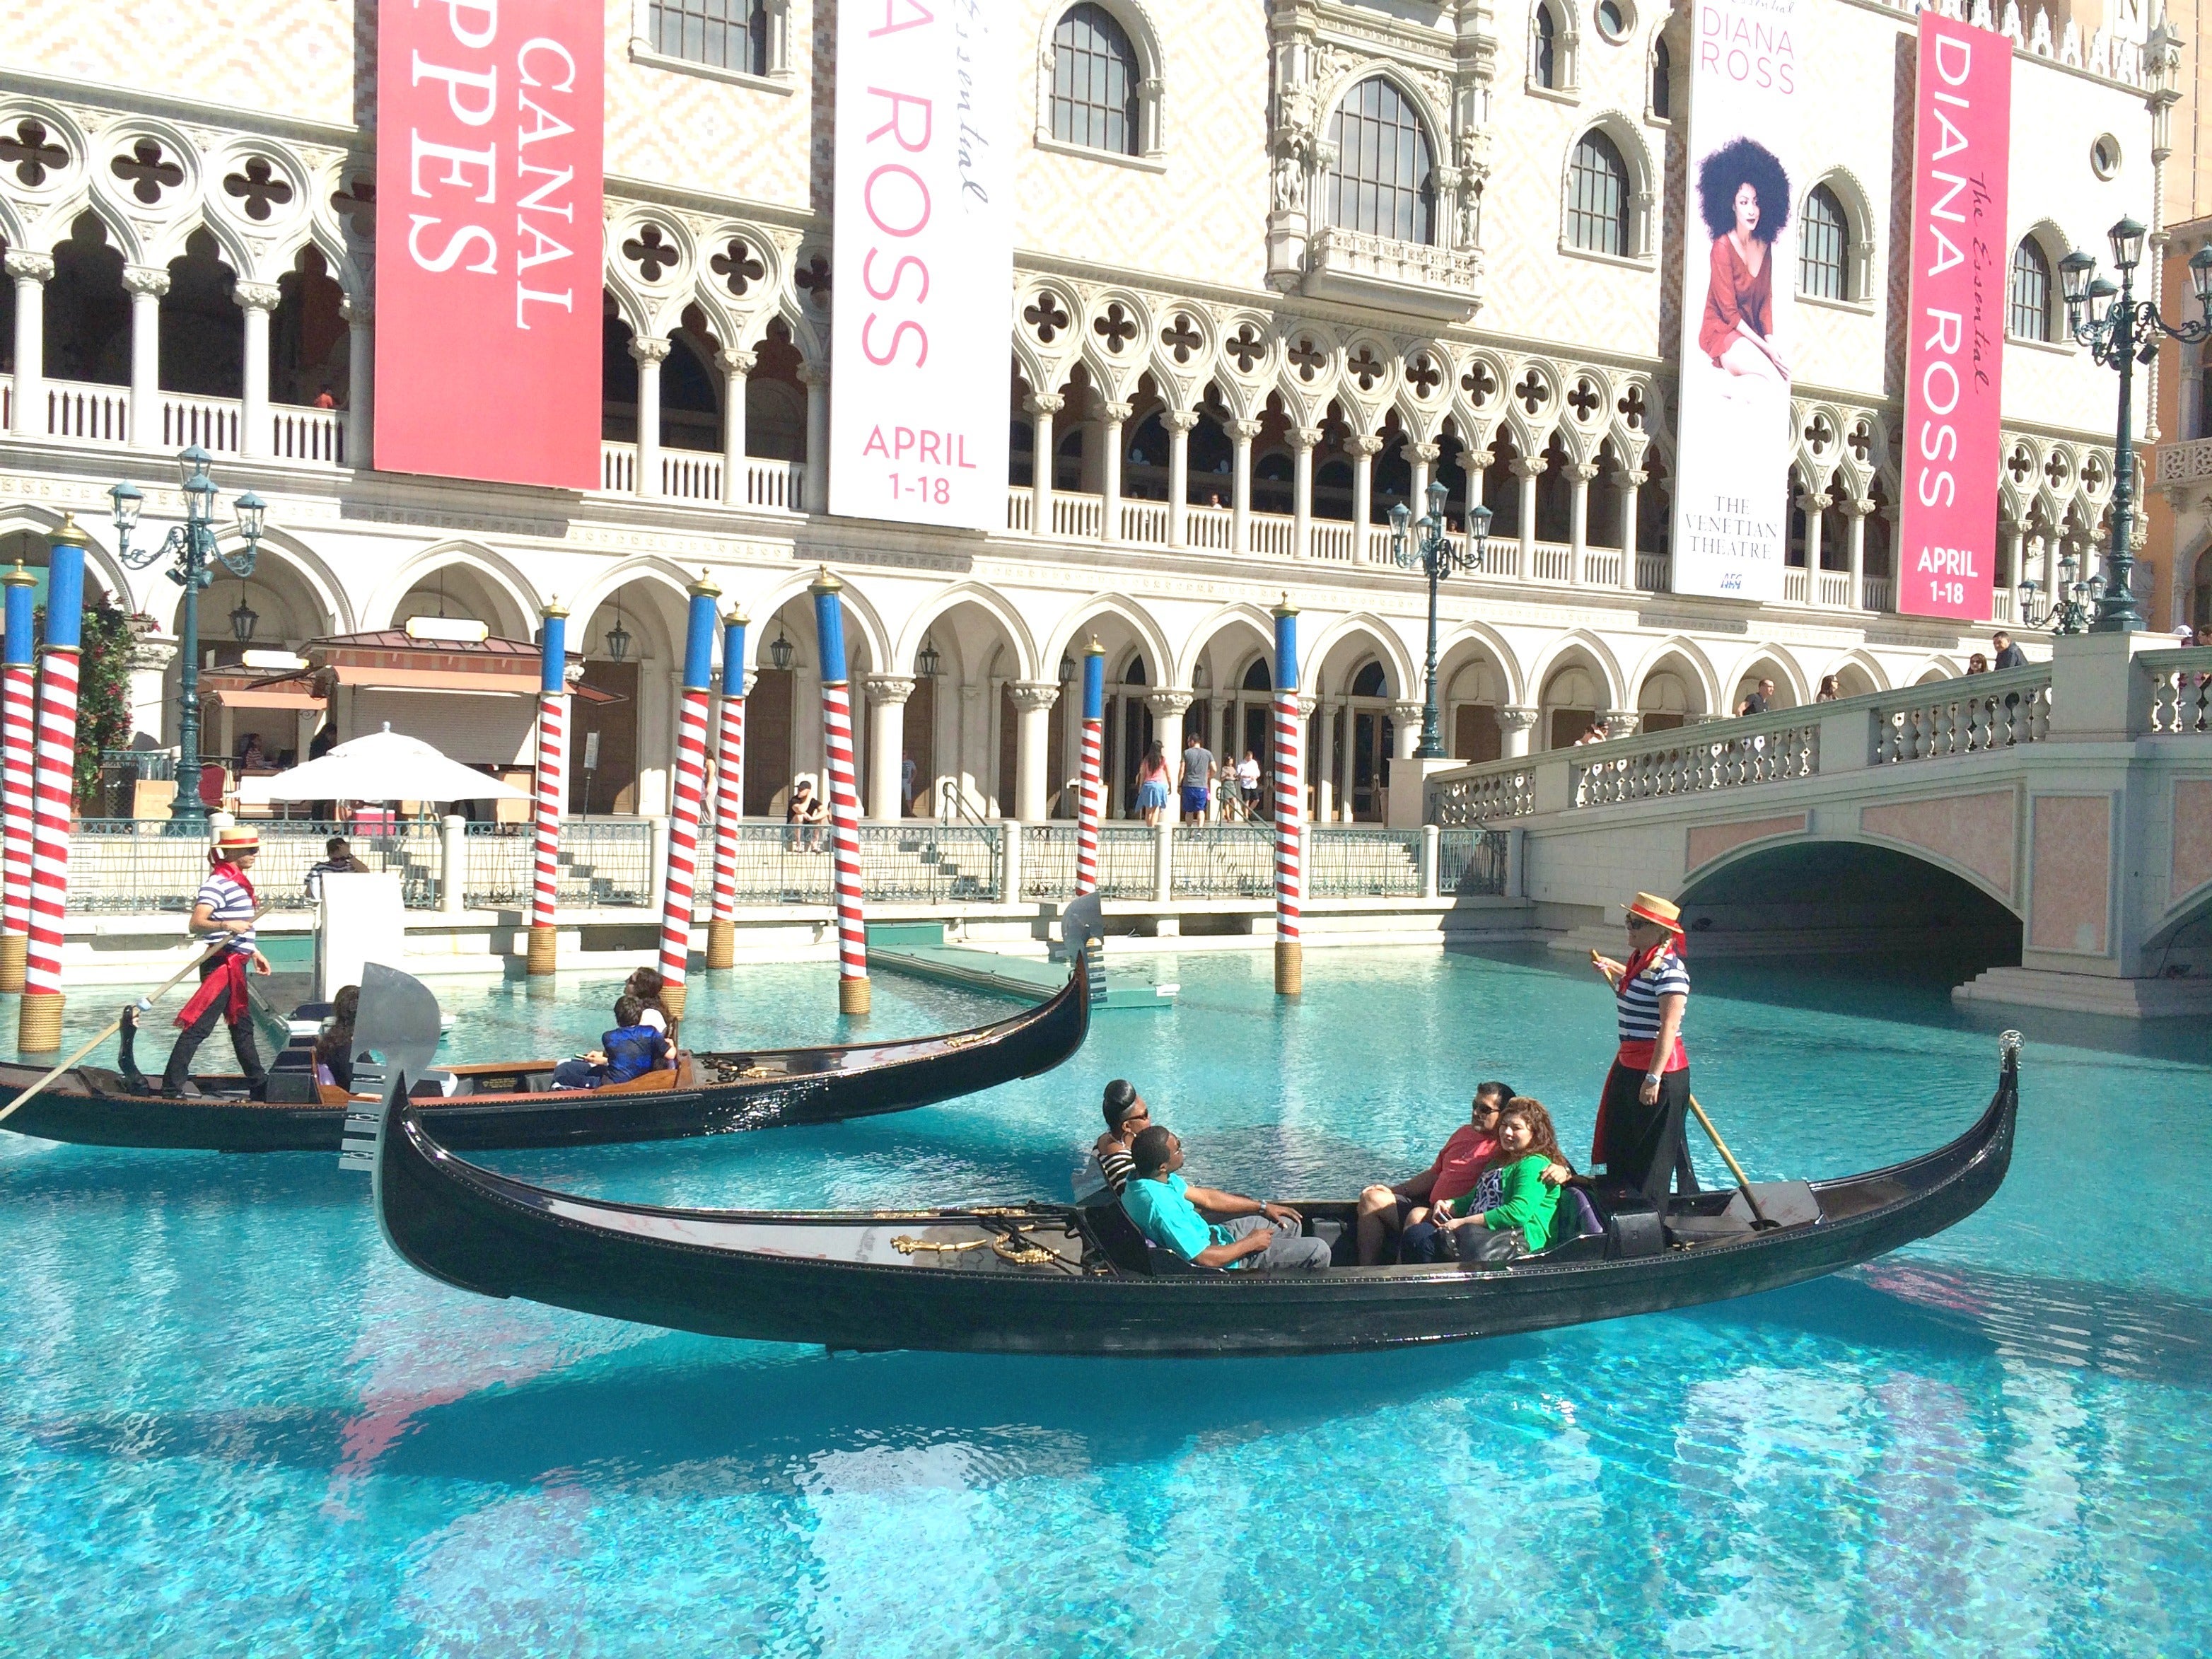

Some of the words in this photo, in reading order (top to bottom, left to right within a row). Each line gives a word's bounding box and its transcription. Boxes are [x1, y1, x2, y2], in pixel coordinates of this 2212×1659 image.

[1703, 6, 1794, 60] DIANA
[1701, 40, 1794, 95] ROSS
[1928, 33, 1971, 277] DIANA
[517, 37, 576, 330] CANAL
[1969, 170, 1992, 227] The
[861, 86, 933, 369] ROSS
[1972, 236, 1992, 395] Essential
[1919, 308, 1962, 508] ROSS
[862, 424, 977, 469] APRIL
[888, 473, 950, 505] 1-18
[1714, 495, 1750, 515] THE
[1686, 513, 1777, 539] VENETIAN
[1690, 535, 1771, 560] THEATRE
[1917, 546, 1978, 578] APRIL
[1930, 581, 1964, 605] 1-18
